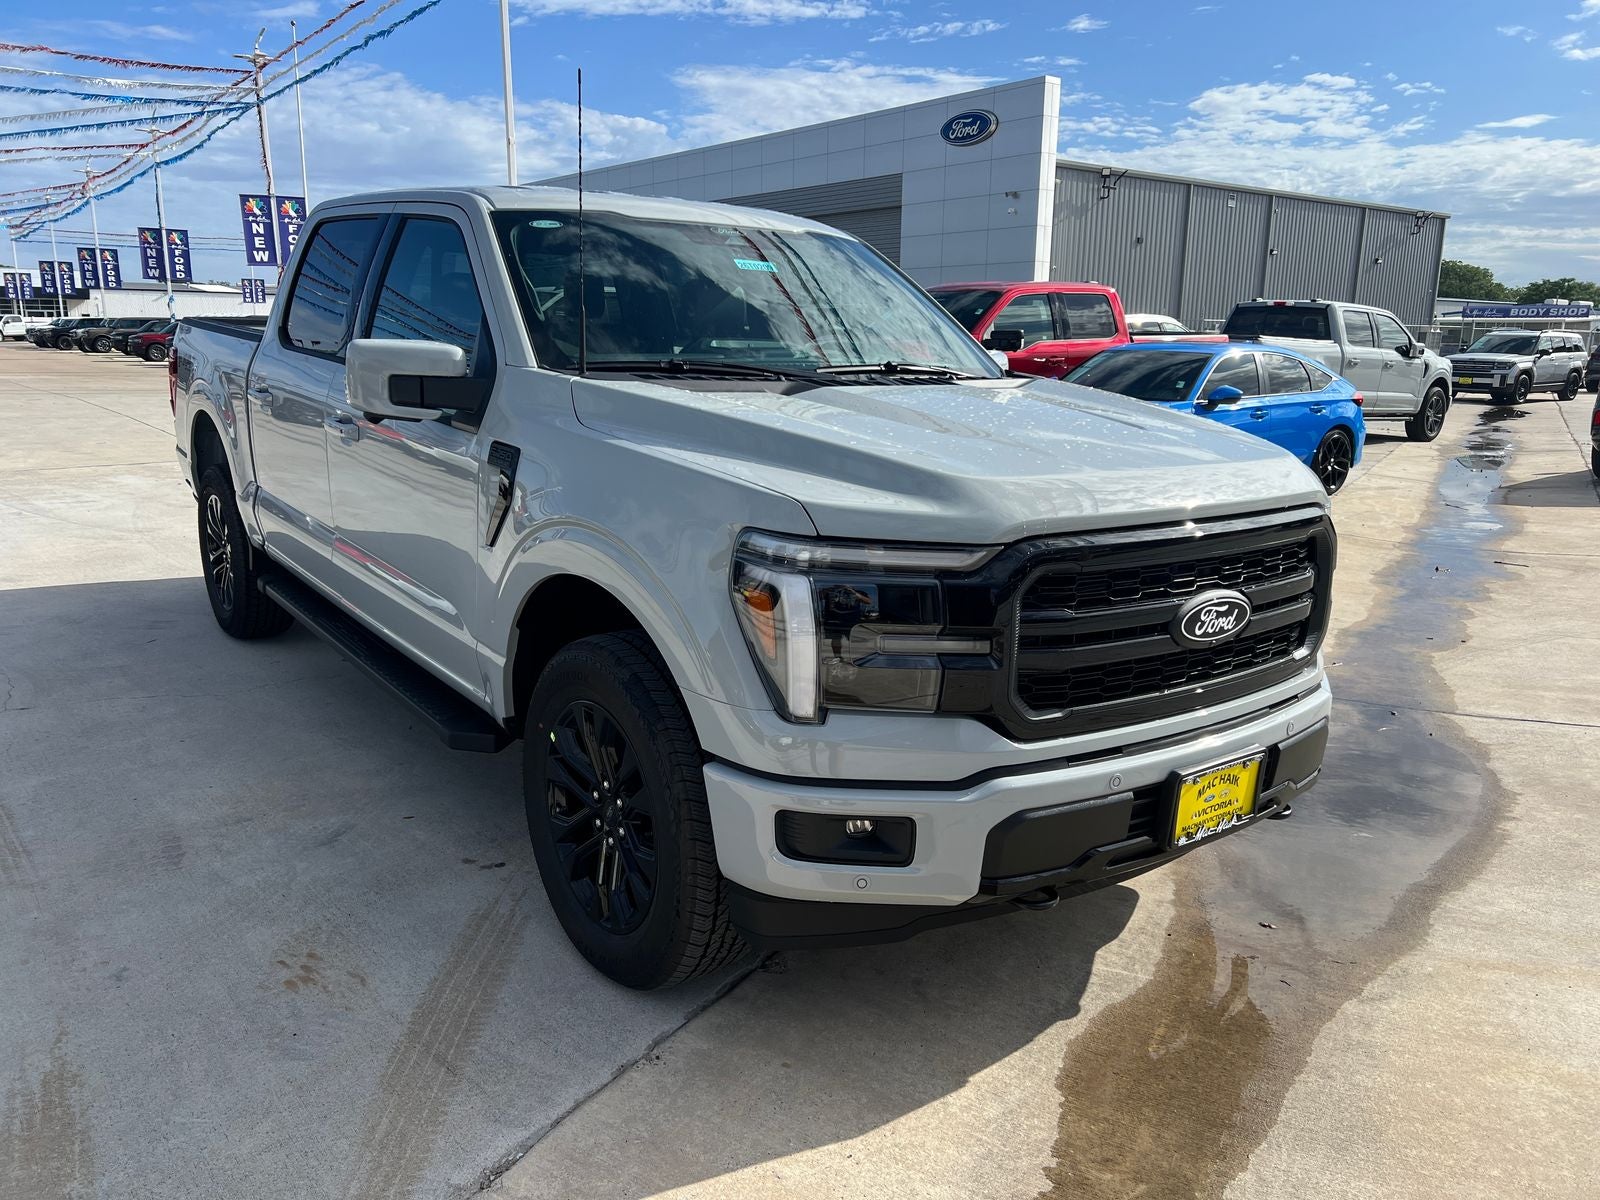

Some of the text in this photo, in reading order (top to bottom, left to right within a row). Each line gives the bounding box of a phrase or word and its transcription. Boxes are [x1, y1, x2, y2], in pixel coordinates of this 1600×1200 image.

[949, 118, 980, 139] Ford
[252, 223, 269, 262] NEW
[146, 248, 160, 277] NEW
[174, 249, 185, 278] FORD
[44, 274, 54, 293] NEW
[63, 274, 72, 294] FORD
[84, 263, 95, 287] NEW
[106, 264, 117, 288] FORD
[1510, 308, 1546, 317] BODY
[1549, 307, 1588, 316] SHOP
[1195, 604, 1239, 636] Ford
[1196, 776, 1219, 800] MAC
[1219, 773, 1241, 787] HAIK
[1197, 799, 1232, 818] VICTORIA
